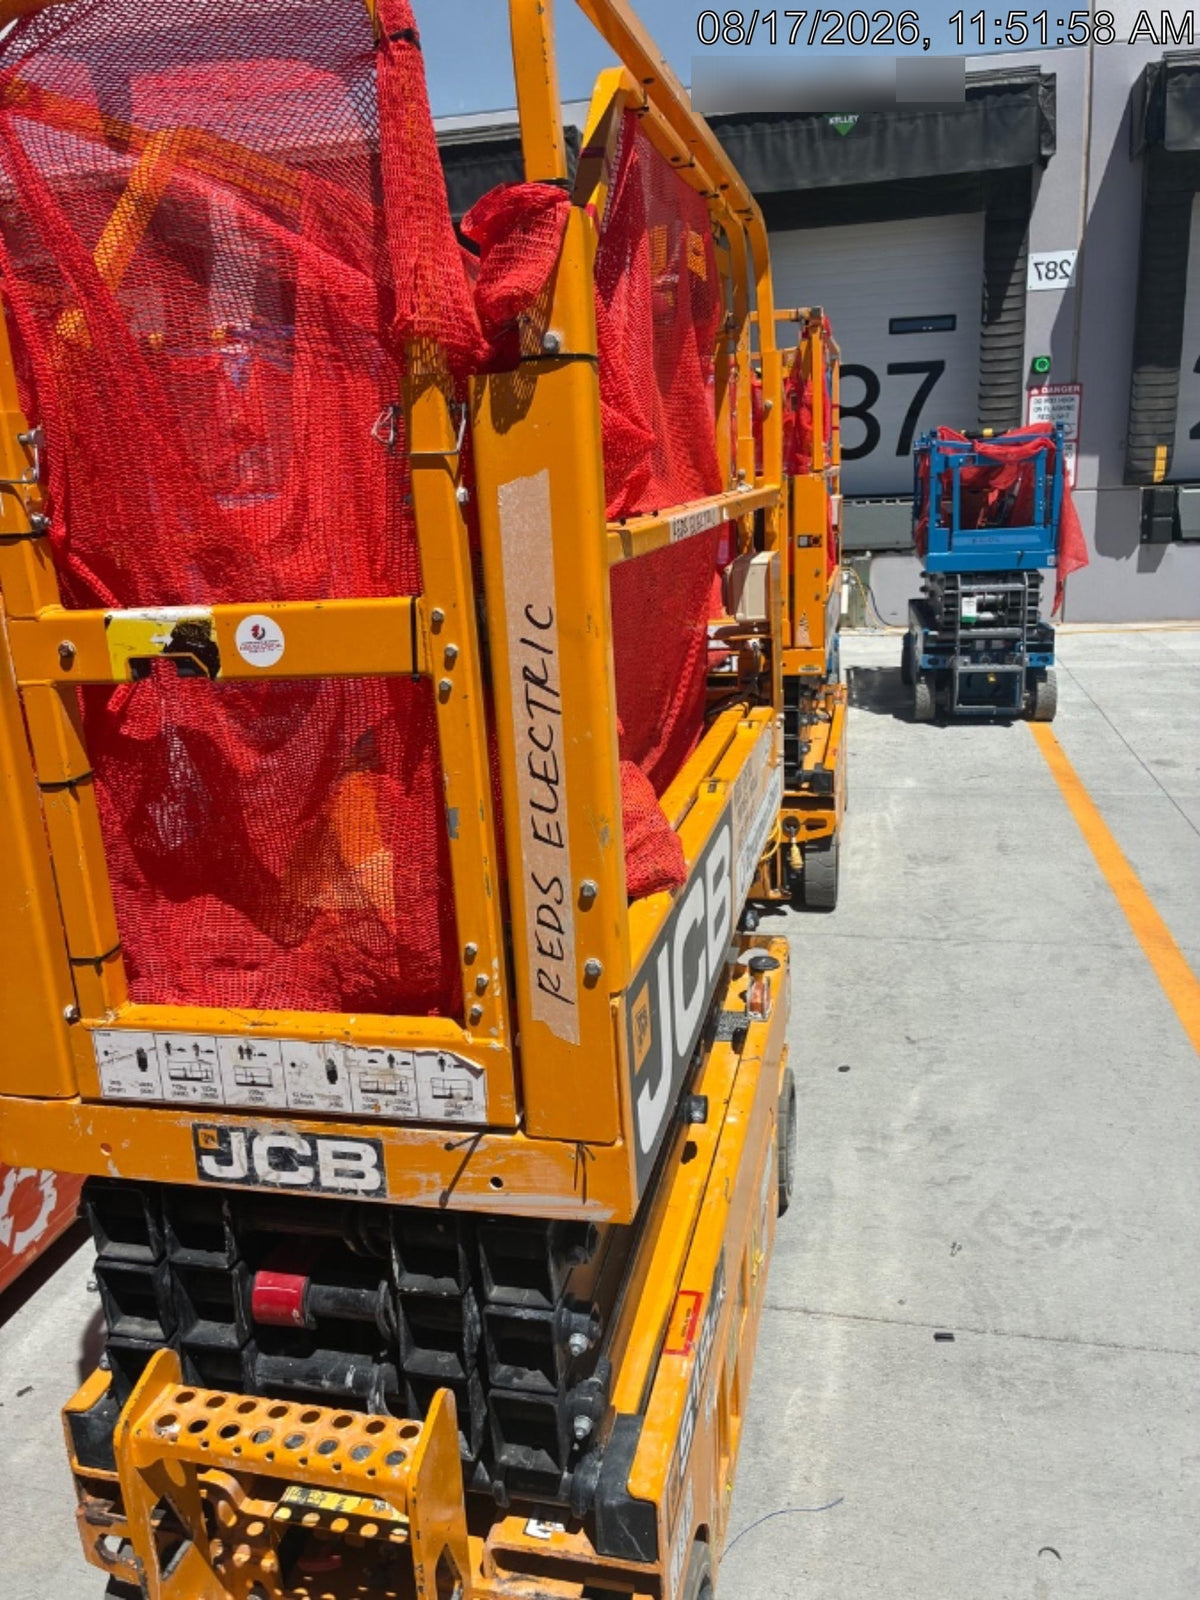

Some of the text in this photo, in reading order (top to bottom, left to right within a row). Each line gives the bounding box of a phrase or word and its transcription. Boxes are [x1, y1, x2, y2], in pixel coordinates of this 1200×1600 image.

[1042, 386, 1080, 394] DANGER
[520, 603, 575, 1005] REDS ELECTRIC
[638, 824, 732, 1154] JCB
[200, 1131, 382, 1191] JCB
